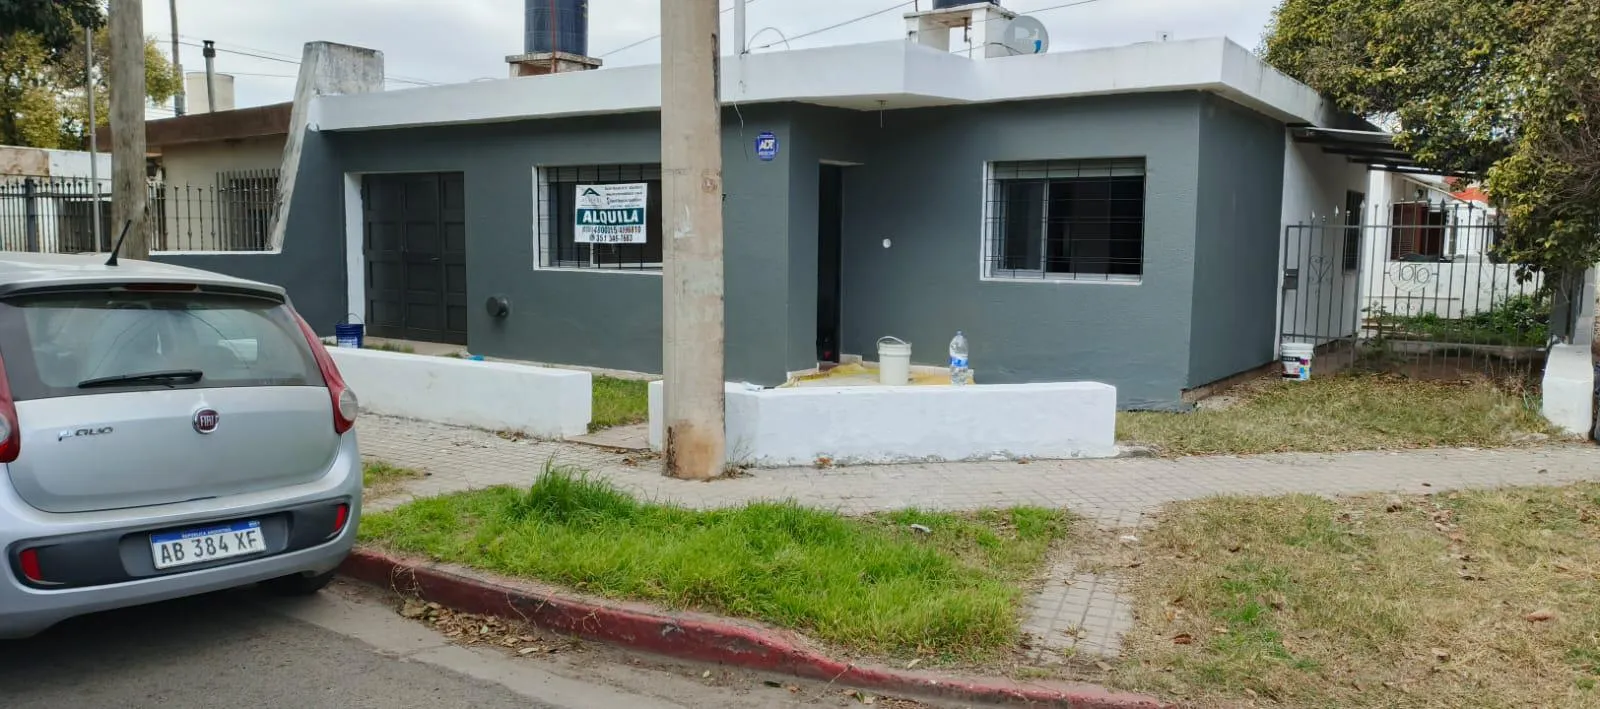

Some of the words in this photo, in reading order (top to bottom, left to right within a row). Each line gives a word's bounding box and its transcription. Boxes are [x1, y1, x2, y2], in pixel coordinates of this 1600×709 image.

[582, 209, 639, 225] ALQUILA
[200, 415, 218, 427] FIAT
[161, 543, 185, 564] AB
[192, 535, 229, 557] 384
[234, 530, 256, 550] XF
